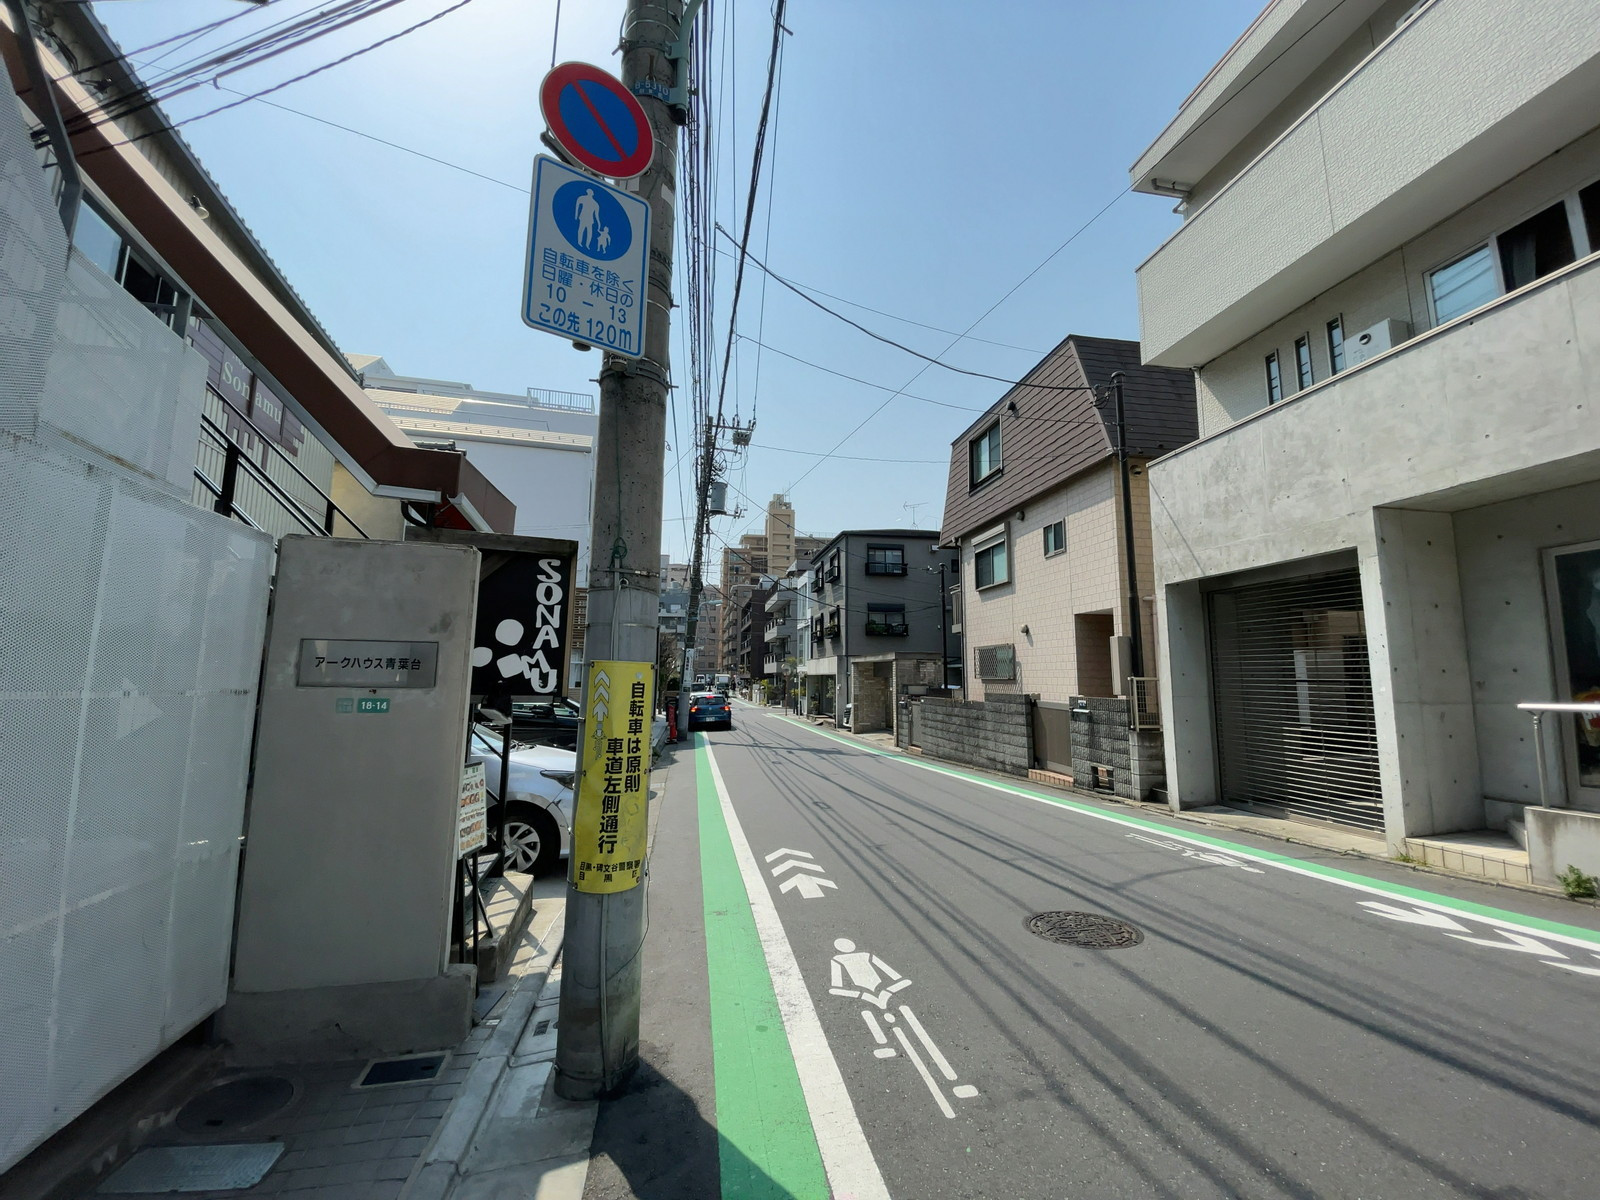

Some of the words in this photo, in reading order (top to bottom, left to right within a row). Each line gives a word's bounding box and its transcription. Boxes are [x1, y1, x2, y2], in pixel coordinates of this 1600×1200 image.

[542, 264, 634, 308] 日曜・休日の
[543, 247, 634, 293] 自転車を除く
[547, 283, 566, 303] 10
[609, 305, 627, 324] 13
[521, 558, 563, 694] SONAMU
[315, 656, 421, 671] アークハウス青葉台
[360, 701, 388, 710] 18-14
[624, 681, 646, 793] 自転車は原則
[597, 737, 624, 854] 車道左側通行
